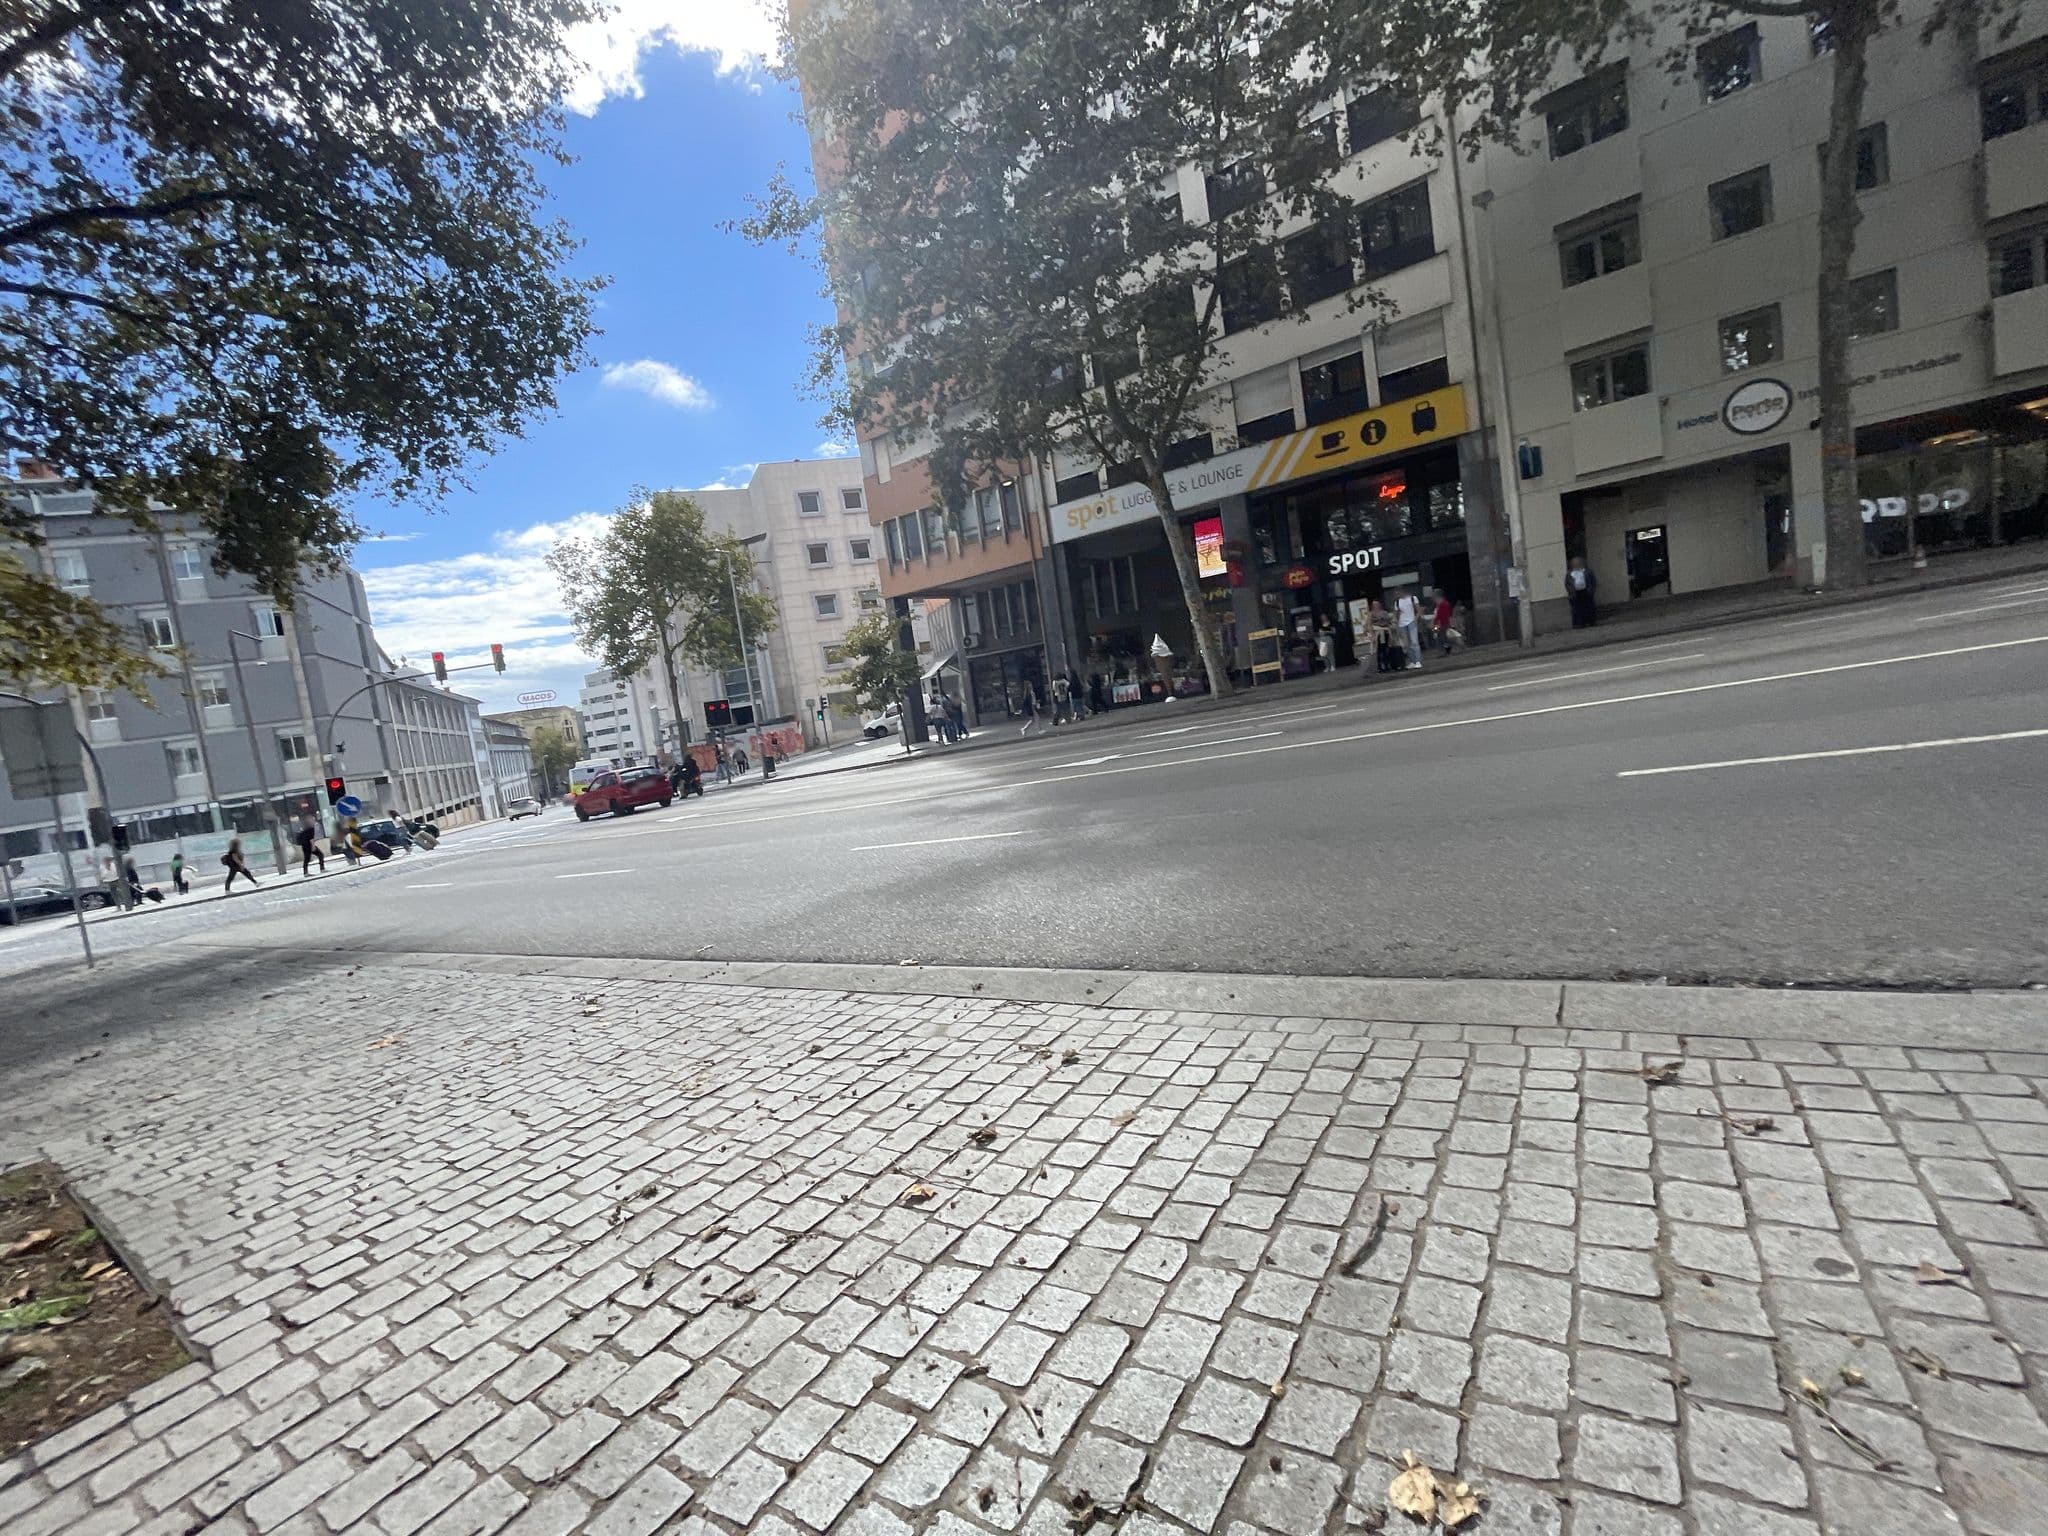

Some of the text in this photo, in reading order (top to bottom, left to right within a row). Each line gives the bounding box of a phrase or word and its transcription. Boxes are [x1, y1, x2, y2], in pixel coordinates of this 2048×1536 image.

[1067, 464, 1243, 530] spot LUGGE & LOUNGE
[1329, 547, 1382, 574] SPOT
